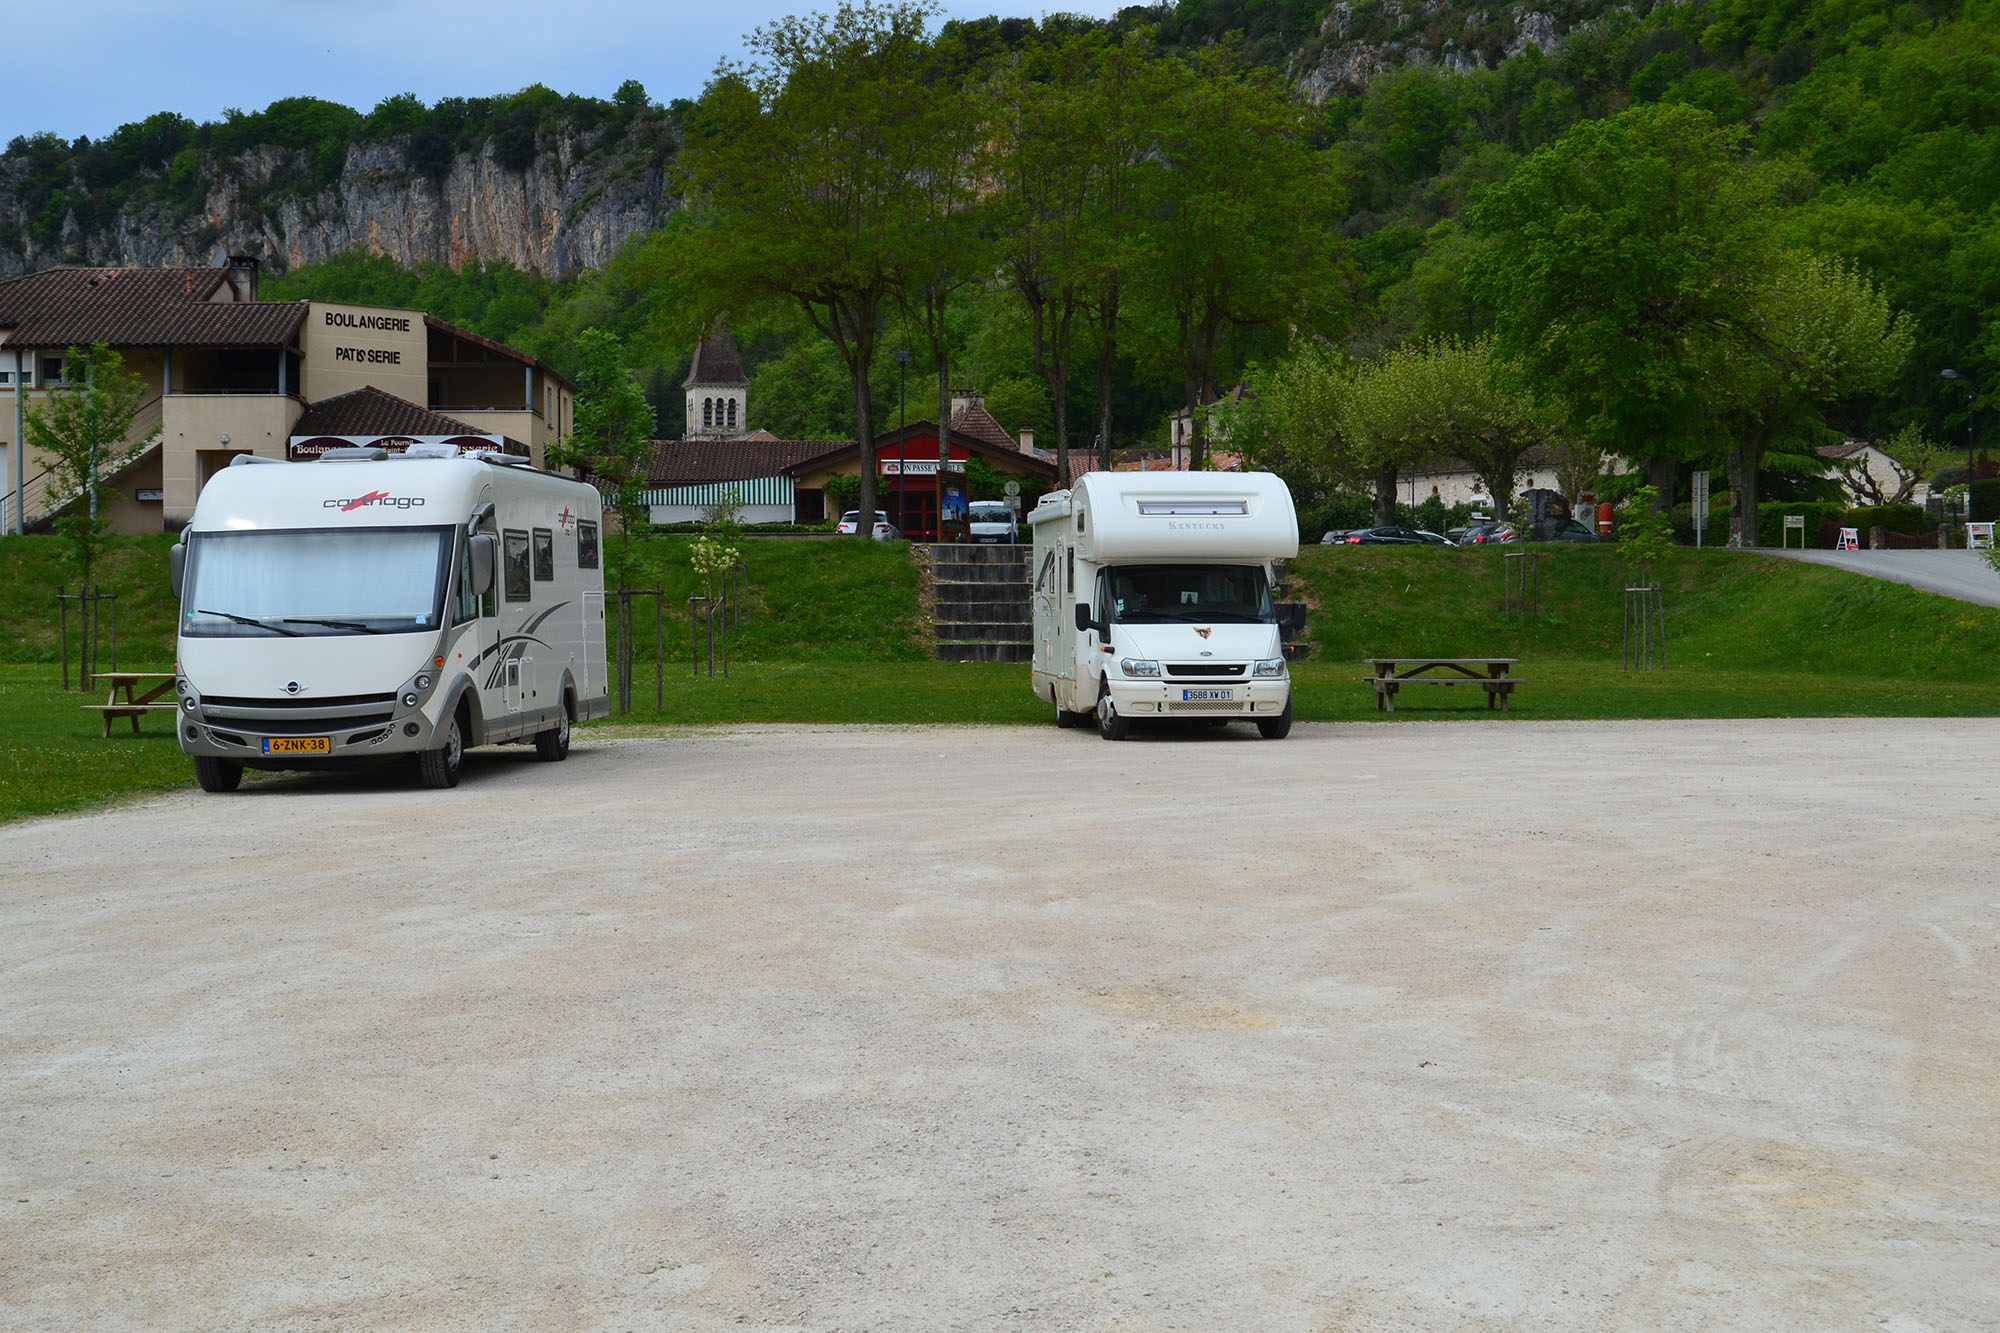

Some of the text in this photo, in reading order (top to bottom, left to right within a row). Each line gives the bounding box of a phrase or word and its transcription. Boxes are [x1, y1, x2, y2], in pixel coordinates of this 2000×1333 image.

[325, 312, 410, 332] BOULANGERIE
[913, 464, 932, 472] PASSE
[323, 494, 425, 510] carthago
[1188, 690, 1230, 699] 3688 XW 01
[272, 739, 325, 750] 6-ZNK-38
